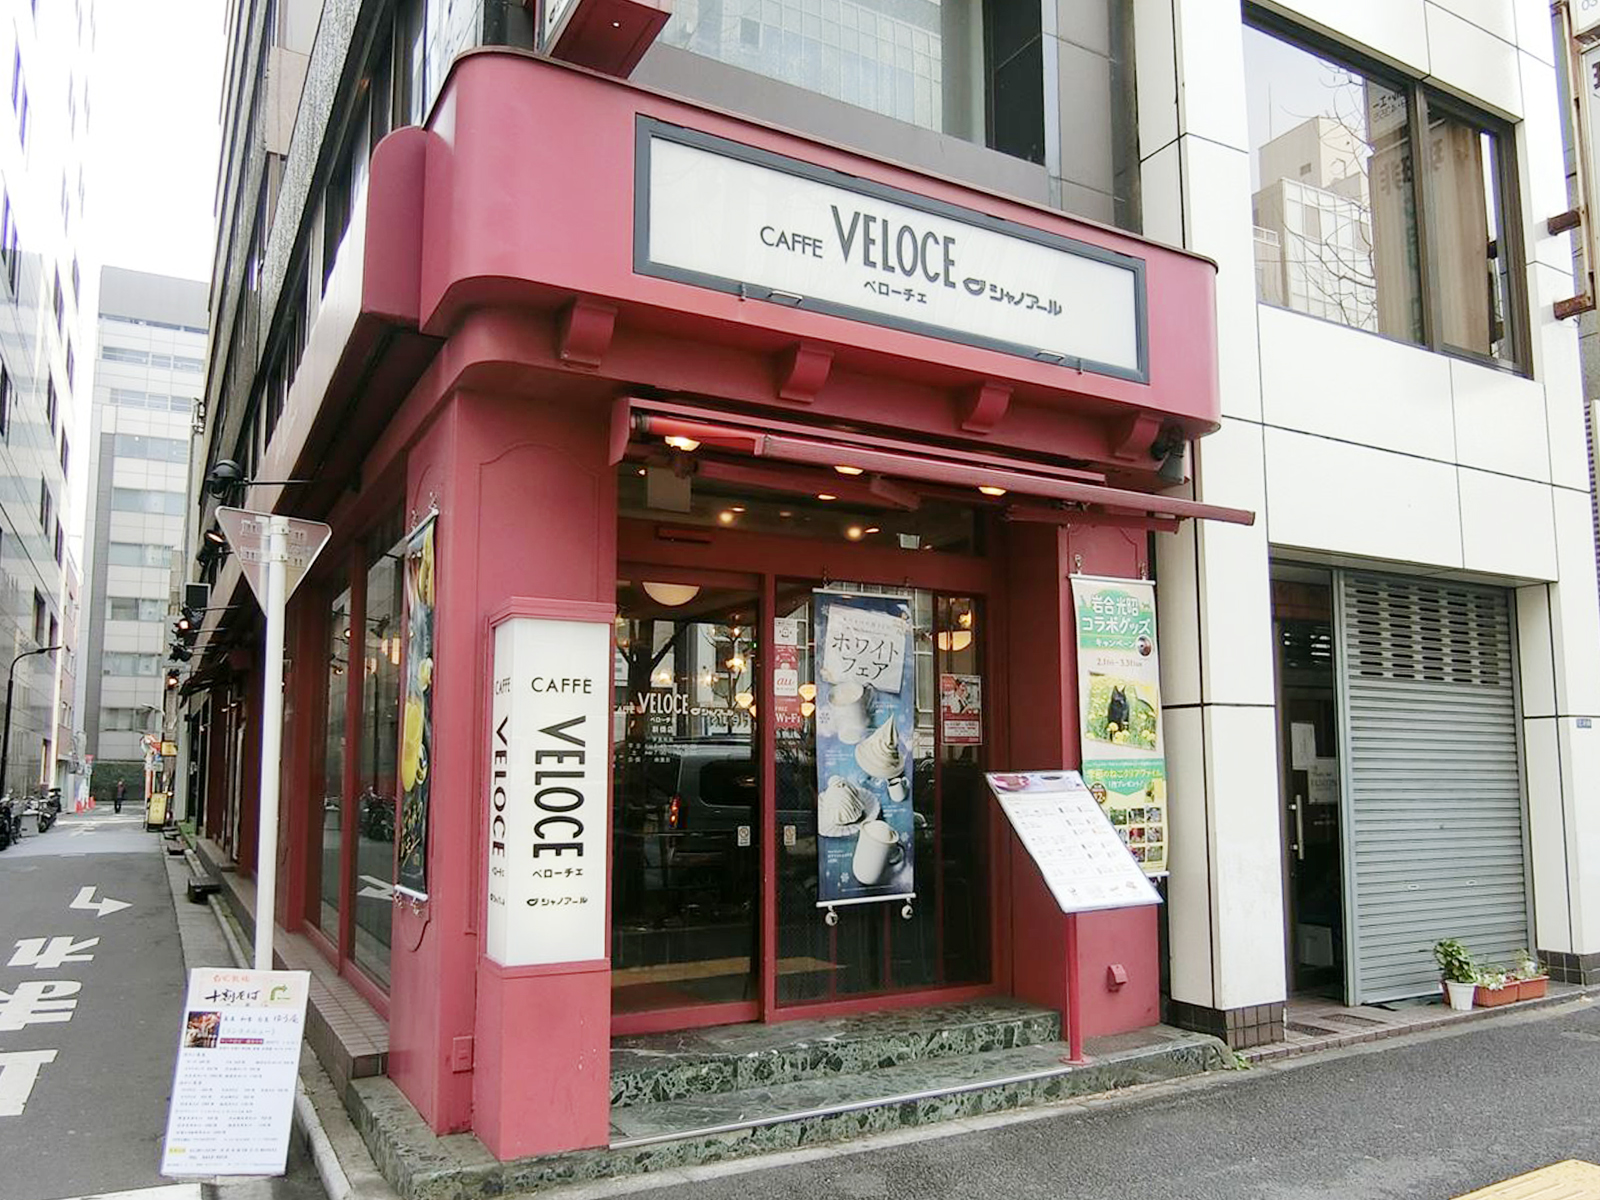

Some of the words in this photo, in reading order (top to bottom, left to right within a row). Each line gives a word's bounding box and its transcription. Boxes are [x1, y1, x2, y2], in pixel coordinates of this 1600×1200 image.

[759, 225, 823, 259] CAFFE
[830, 204, 957, 290] VELOCE
[864, 279, 928, 305] ベローチェ
[989, 282, 1063, 317] シャノアール
[1081, 616, 1151, 635] コラボグッズ
[831, 632, 900, 664] ホワイト
[842, 656, 889, 681] フェア
[531, 676, 593, 695] CAFFE
[776, 677, 793, 687] au
[638, 692, 689, 715] VELOCE
[493, 715, 509, 858] VELOCE
[533, 715, 587, 858] VELOCE
[532, 867, 584, 878] ベローチェ
[542, 896, 588, 906] シャノアール
